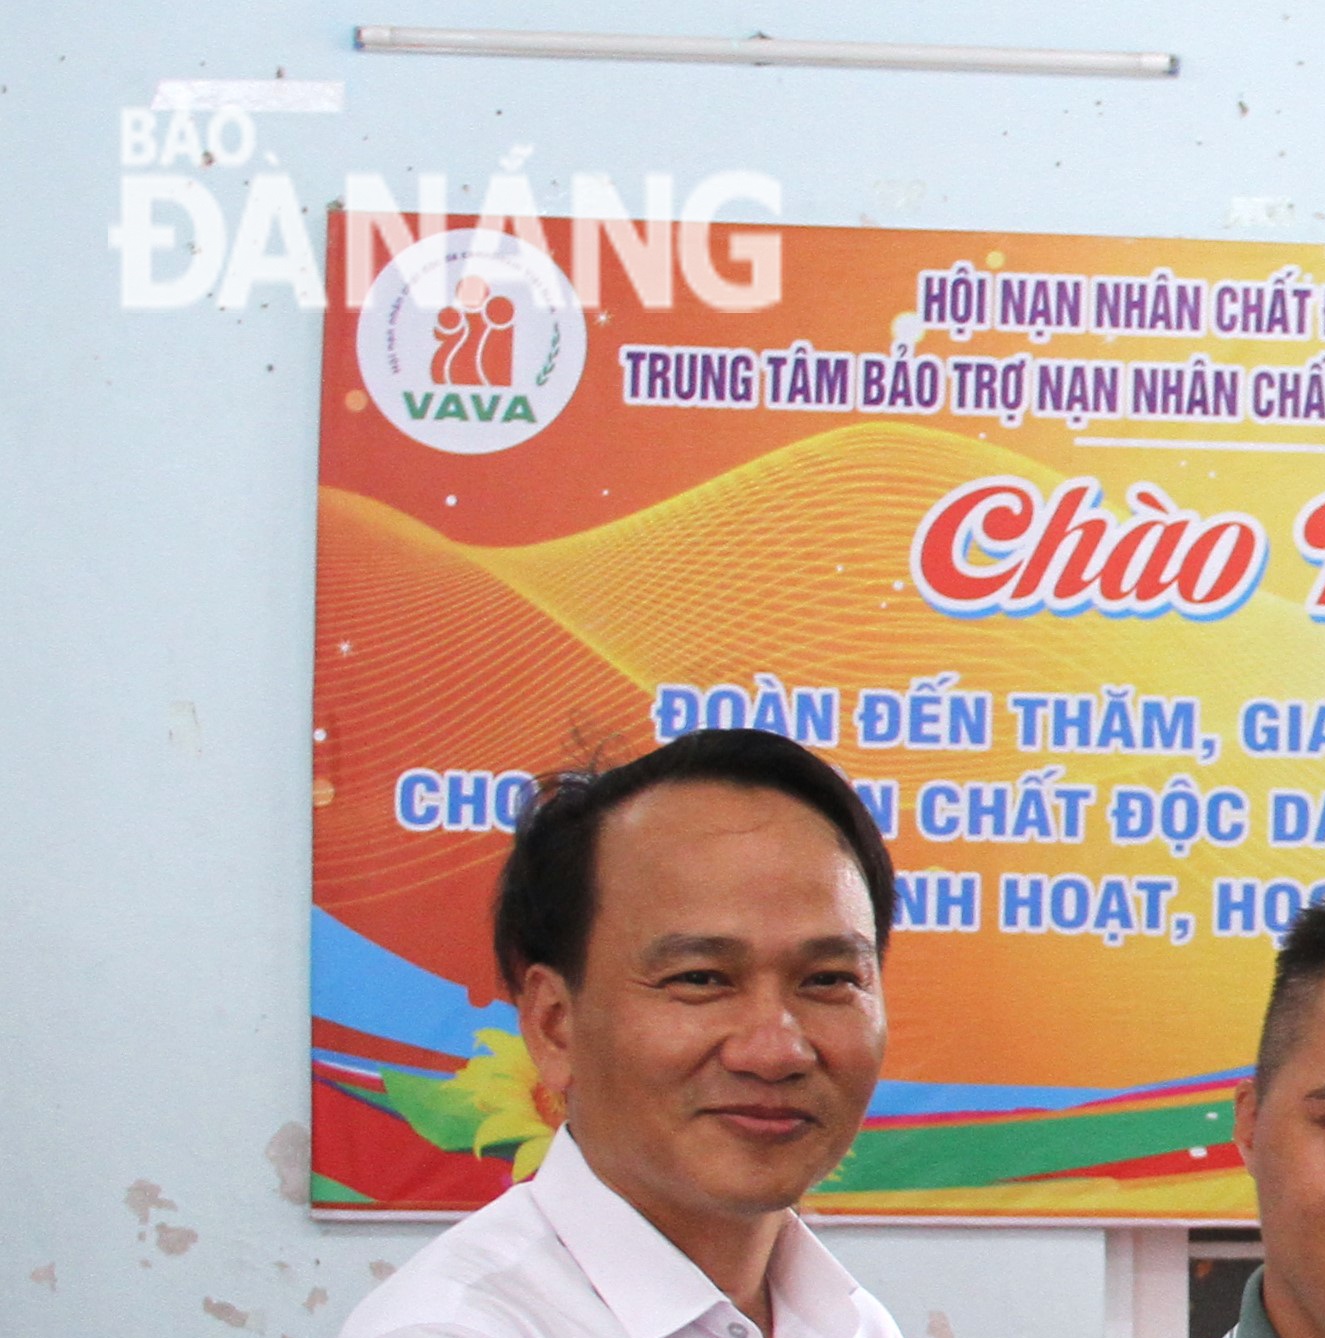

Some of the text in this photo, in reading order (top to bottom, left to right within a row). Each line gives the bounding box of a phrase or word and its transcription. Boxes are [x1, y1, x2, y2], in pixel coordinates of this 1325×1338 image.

[923, 267, 986, 334] HỘI
[1000, 279, 1081, 337] NẠN
[1095, 274, 1200, 331] NHÂN
[1216, 271, 1311, 335] CHẤT
[403, 391, 536, 423] VAVA
[627, 351, 753, 402] TRUNG
[767, 347, 849, 405] TÂM
[863, 343, 939, 407] BẢO
[953, 358, 1026, 421] TRỢ
[1038, 365, 1118, 422] NẠN
[1133, 360, 1238, 416] NHÂN
[918, 483, 1260, 604] Chào
[656, 677, 832, 742] ĐOÀN
[859, 676, 987, 745] ĐẾN
[1013, 689, 1216, 760] THĂM,
[921, 769, 1091, 837] CHẤT
[1111, 779, 1247, 851] ĐỘC
[1004, 878, 1190, 941] HOẠT,
